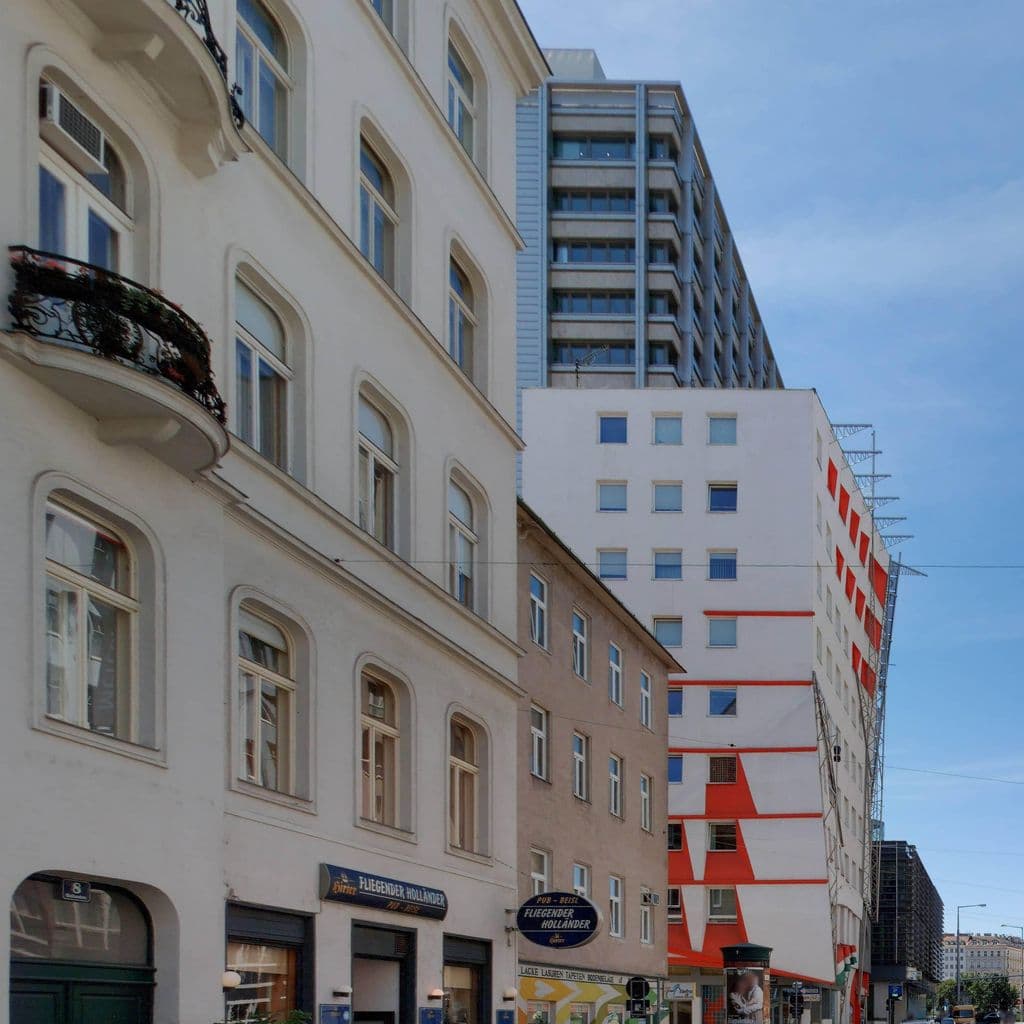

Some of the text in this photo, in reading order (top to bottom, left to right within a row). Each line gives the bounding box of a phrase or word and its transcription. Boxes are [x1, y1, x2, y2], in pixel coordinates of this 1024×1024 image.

[72, 882, 82, 894] 8
[359, 876, 446, 908] FLIEGENDER HOLLÄNDER
[537, 896, 552, 904] PUB
[524, 908, 575, 918] FLIEGENDER
[541, 918, 591, 929] HOLLÄNDER
[565, 970, 586, 980] TAPETEN
